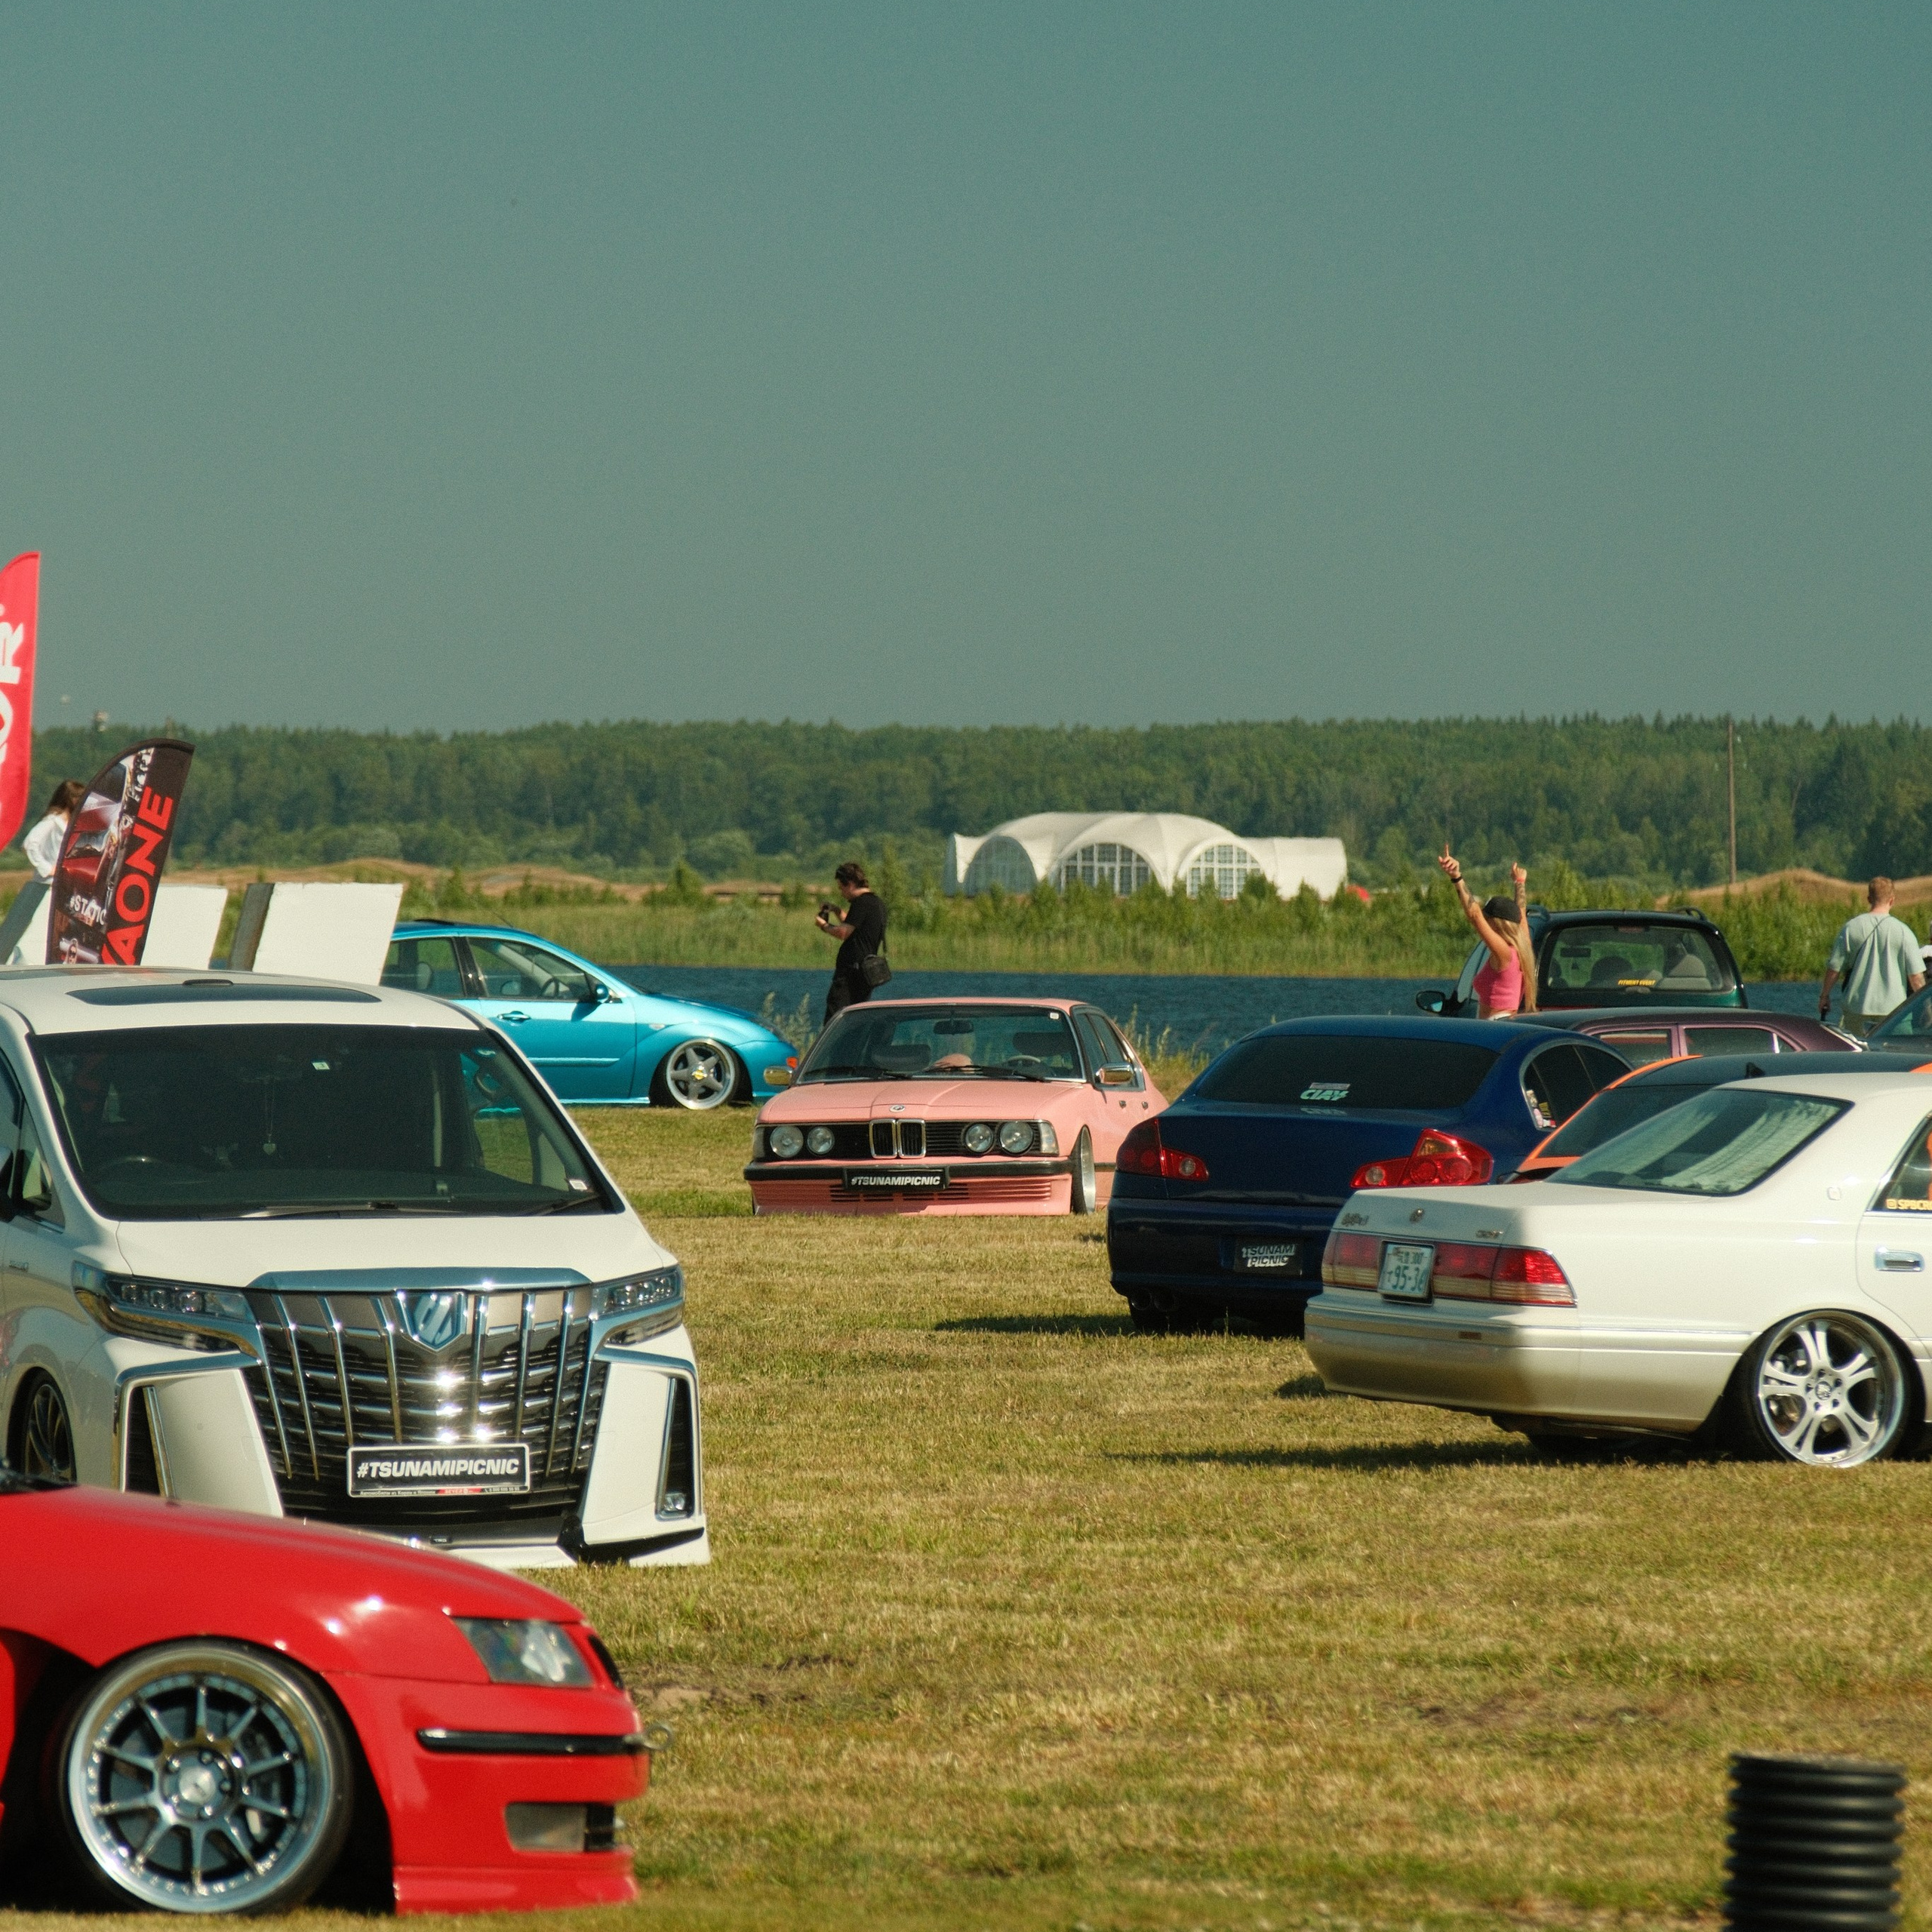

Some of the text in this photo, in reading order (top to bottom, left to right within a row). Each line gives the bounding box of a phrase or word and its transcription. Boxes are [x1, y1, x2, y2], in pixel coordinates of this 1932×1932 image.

[69, 894, 107, 925] #STATIC
[851, 1176, 940, 1186] #TSUNAMIPICNIC
[1241, 1244, 1296, 1258] TSUNAMI
[1247, 1256, 1289, 1268] PICNIC
[357, 1458, 519, 1478] #TSUNAMIPICNIC
